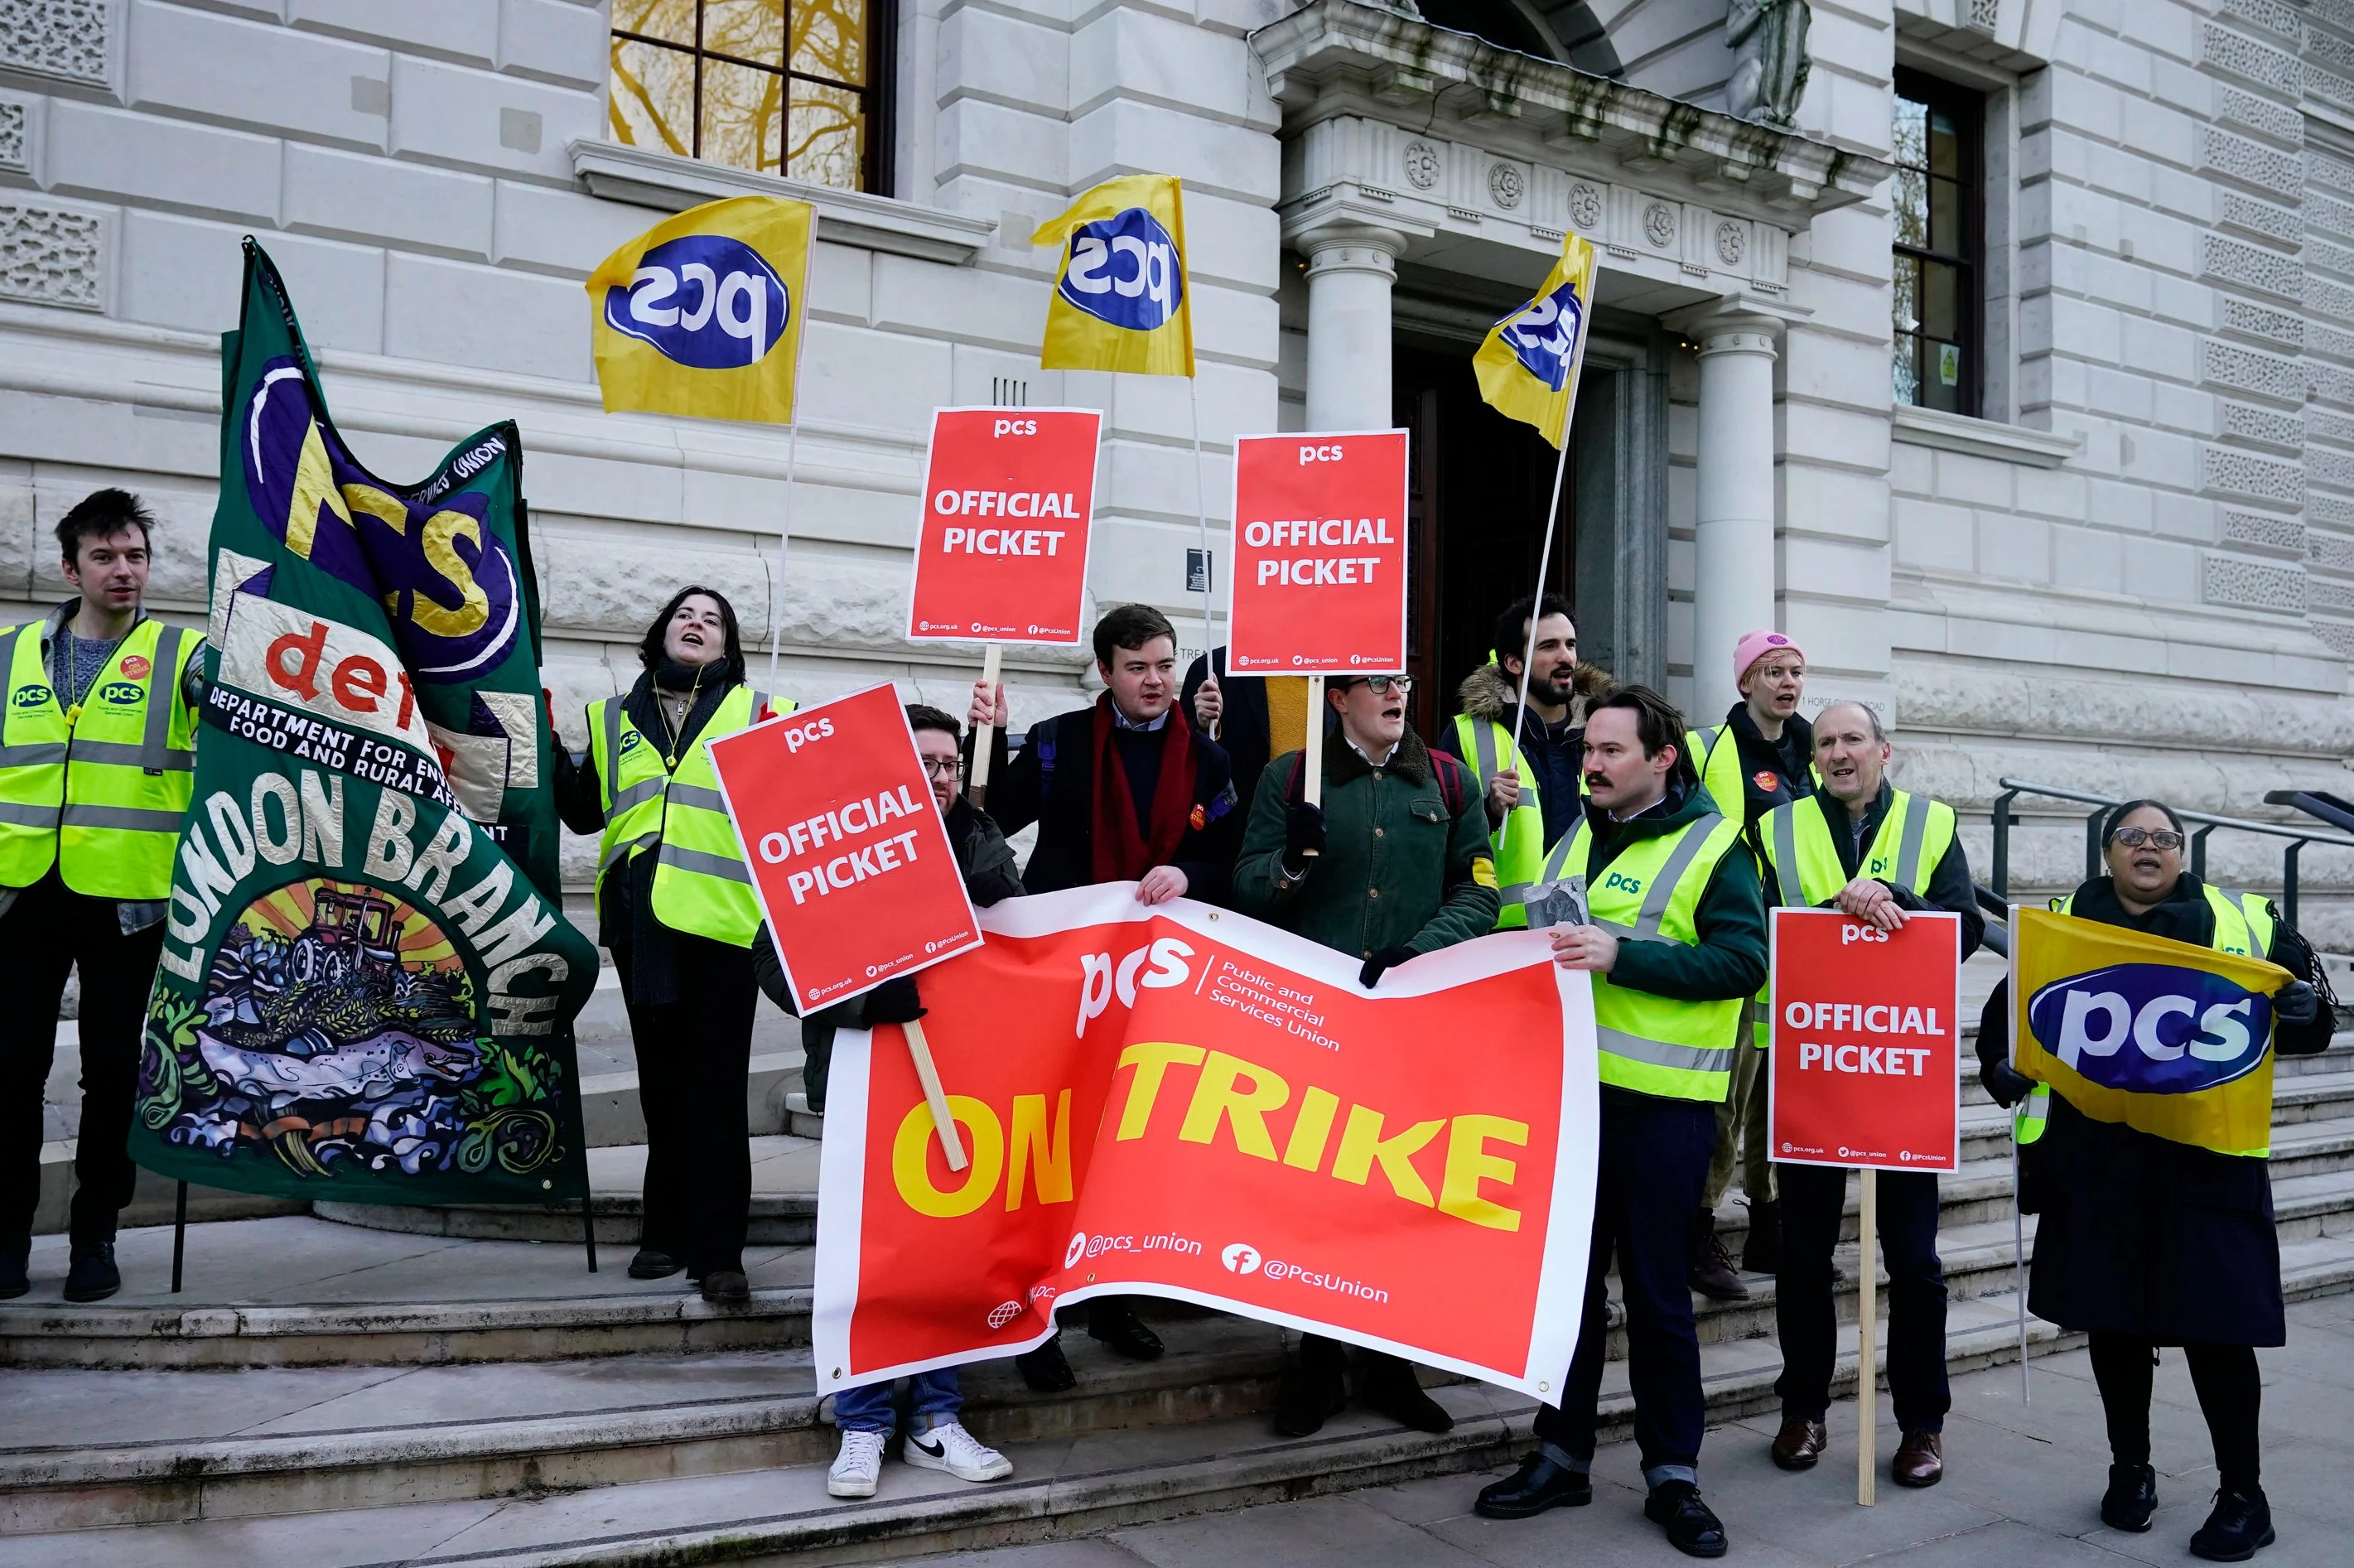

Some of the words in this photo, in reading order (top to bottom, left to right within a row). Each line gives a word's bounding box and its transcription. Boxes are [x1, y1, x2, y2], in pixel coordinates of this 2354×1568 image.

[994, 417, 1037, 438] pcs
[453, 437, 506, 479] UNION
[1299, 444, 1343, 466] pcs
[933, 490, 1081, 520] OFFICIAL
[943, 528, 1065, 557] PICKET
[1244, 518, 1395, 548] OFFICIAL
[1257, 557, 1381, 586] PICKET
[982, 625, 1016, 633] @pcs_union
[1303, 657, 1338, 665] @pcs_union
[16, 688, 47, 707] pcs
[104, 687, 141, 702] pcs
[210, 686, 355, 752] DEPARTMENT
[359, 741, 407, 769] FOR
[784, 717, 835, 753] pcs
[229, 715, 288, 750] FOOD
[294, 741, 345, 770] AND
[354, 760, 425, 797] RURAL
[759, 784, 924, 864] OFFICIAL
[787, 829, 918, 905] PICKET
[1605, 872, 1641, 895] pcs
[161, 769, 344, 983] LONDON
[363, 785, 569, 1036] BRANCH
[1841, 923, 1889, 946] pcs
[821, 977, 853, 996] pcs.org.uk
[877, 953, 914, 972] @pcs_union
[937, 930, 969, 948] @PcsUnion
[1077, 937, 1195, 1039] pcs
[1217, 975, 1324, 1027] Commercial
[1223, 961, 1276, 991] Public
[1278, 986, 1314, 1006] and
[1209, 989, 1283, 1027] Services
[1287, 1020, 1340, 1052] Union
[1785, 1001, 1945, 1037] OFFICIAL
[2056, 987, 2251, 1071] pcs
[1798, 1042, 1931, 1077] PICKET
[892, 1088, 1073, 1218] ON
[1116, 1041, 1529, 1232] TRIKE
[1850, 1150, 1887, 1158] @pcs_union
[1086, 1232, 1202, 1258] @pcs_union
[1263, 1258, 1388, 1304] @PcsUnion
